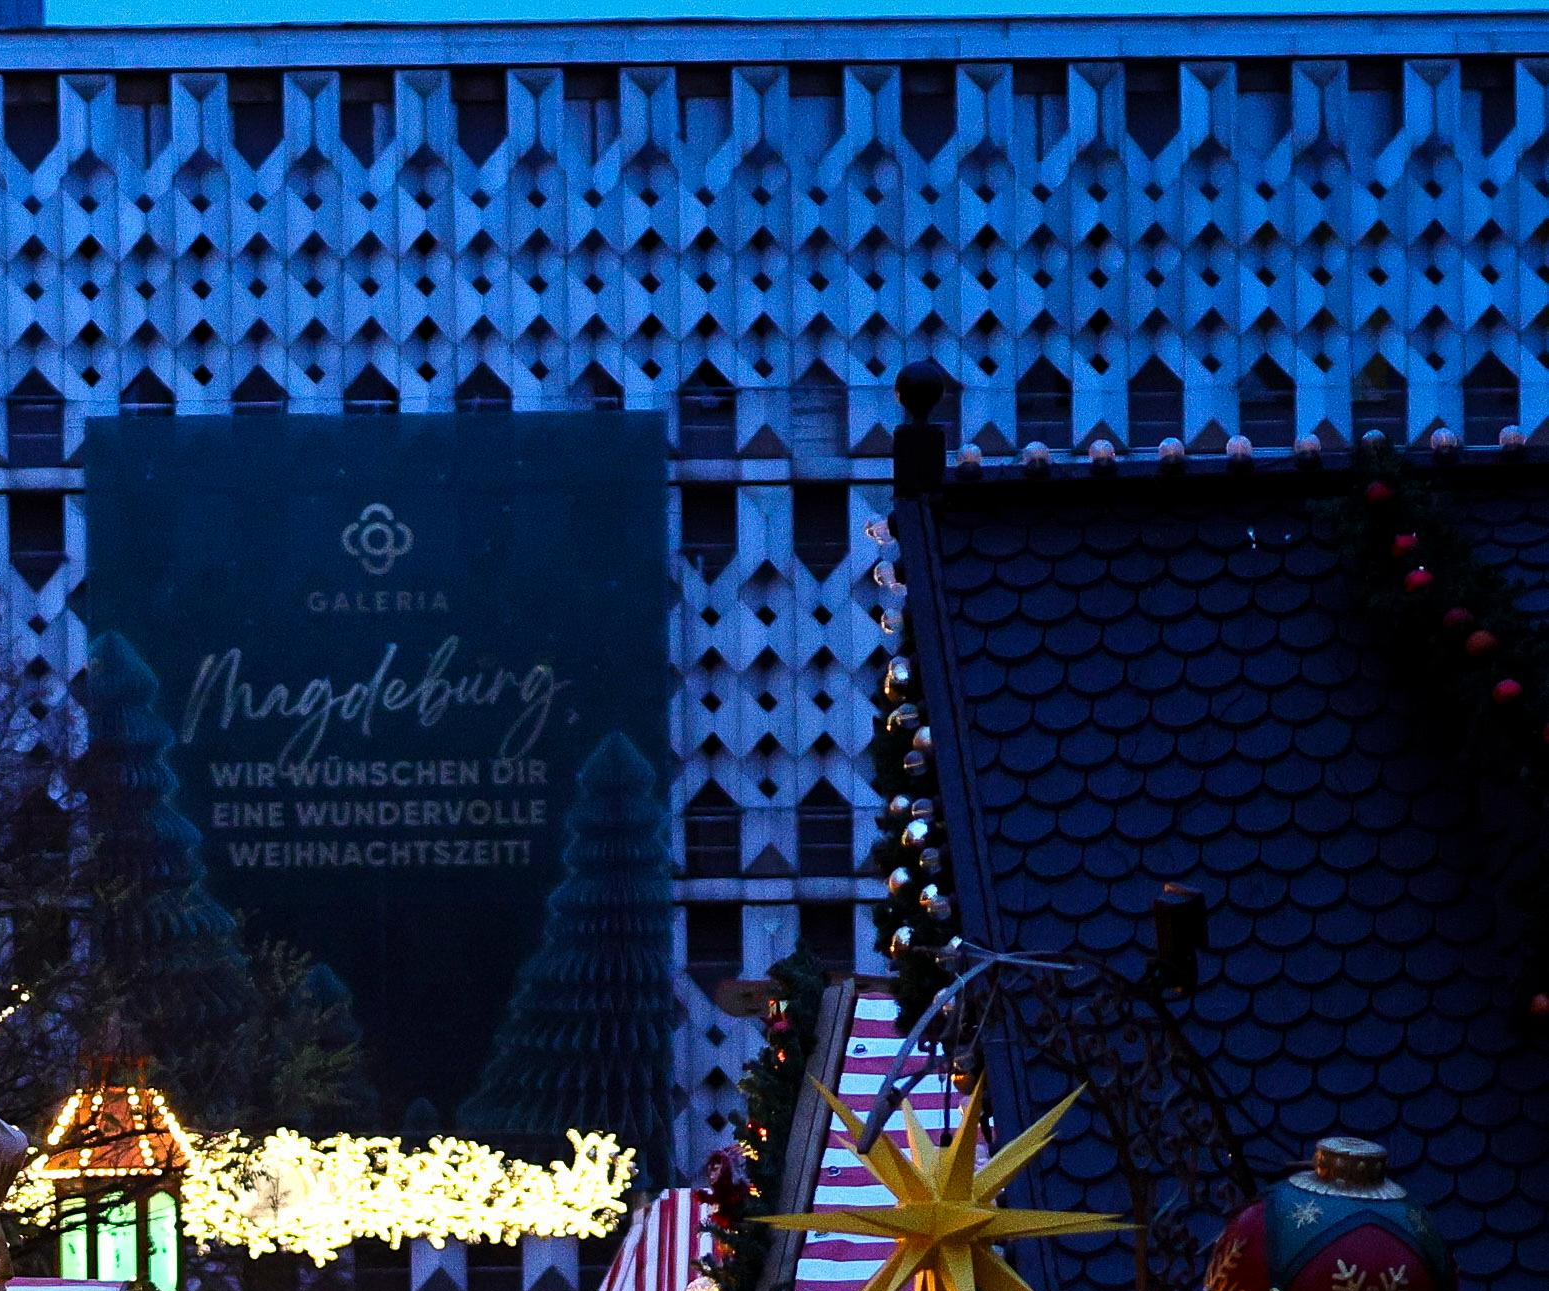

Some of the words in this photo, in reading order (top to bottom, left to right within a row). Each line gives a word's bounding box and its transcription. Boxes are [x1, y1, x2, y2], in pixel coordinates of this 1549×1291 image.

[306, 590, 450, 613] GALERIA
[209, 761, 279, 789] WIR
[291, 755, 480, 788] WÜNSCHEN
[491, 758, 549, 786] DIR
[212, 802, 285, 828] EINE
[296, 800, 547, 827] WUNDERVOLLE
[230, 840, 531, 867] WEIHNACHTSZEIT!
